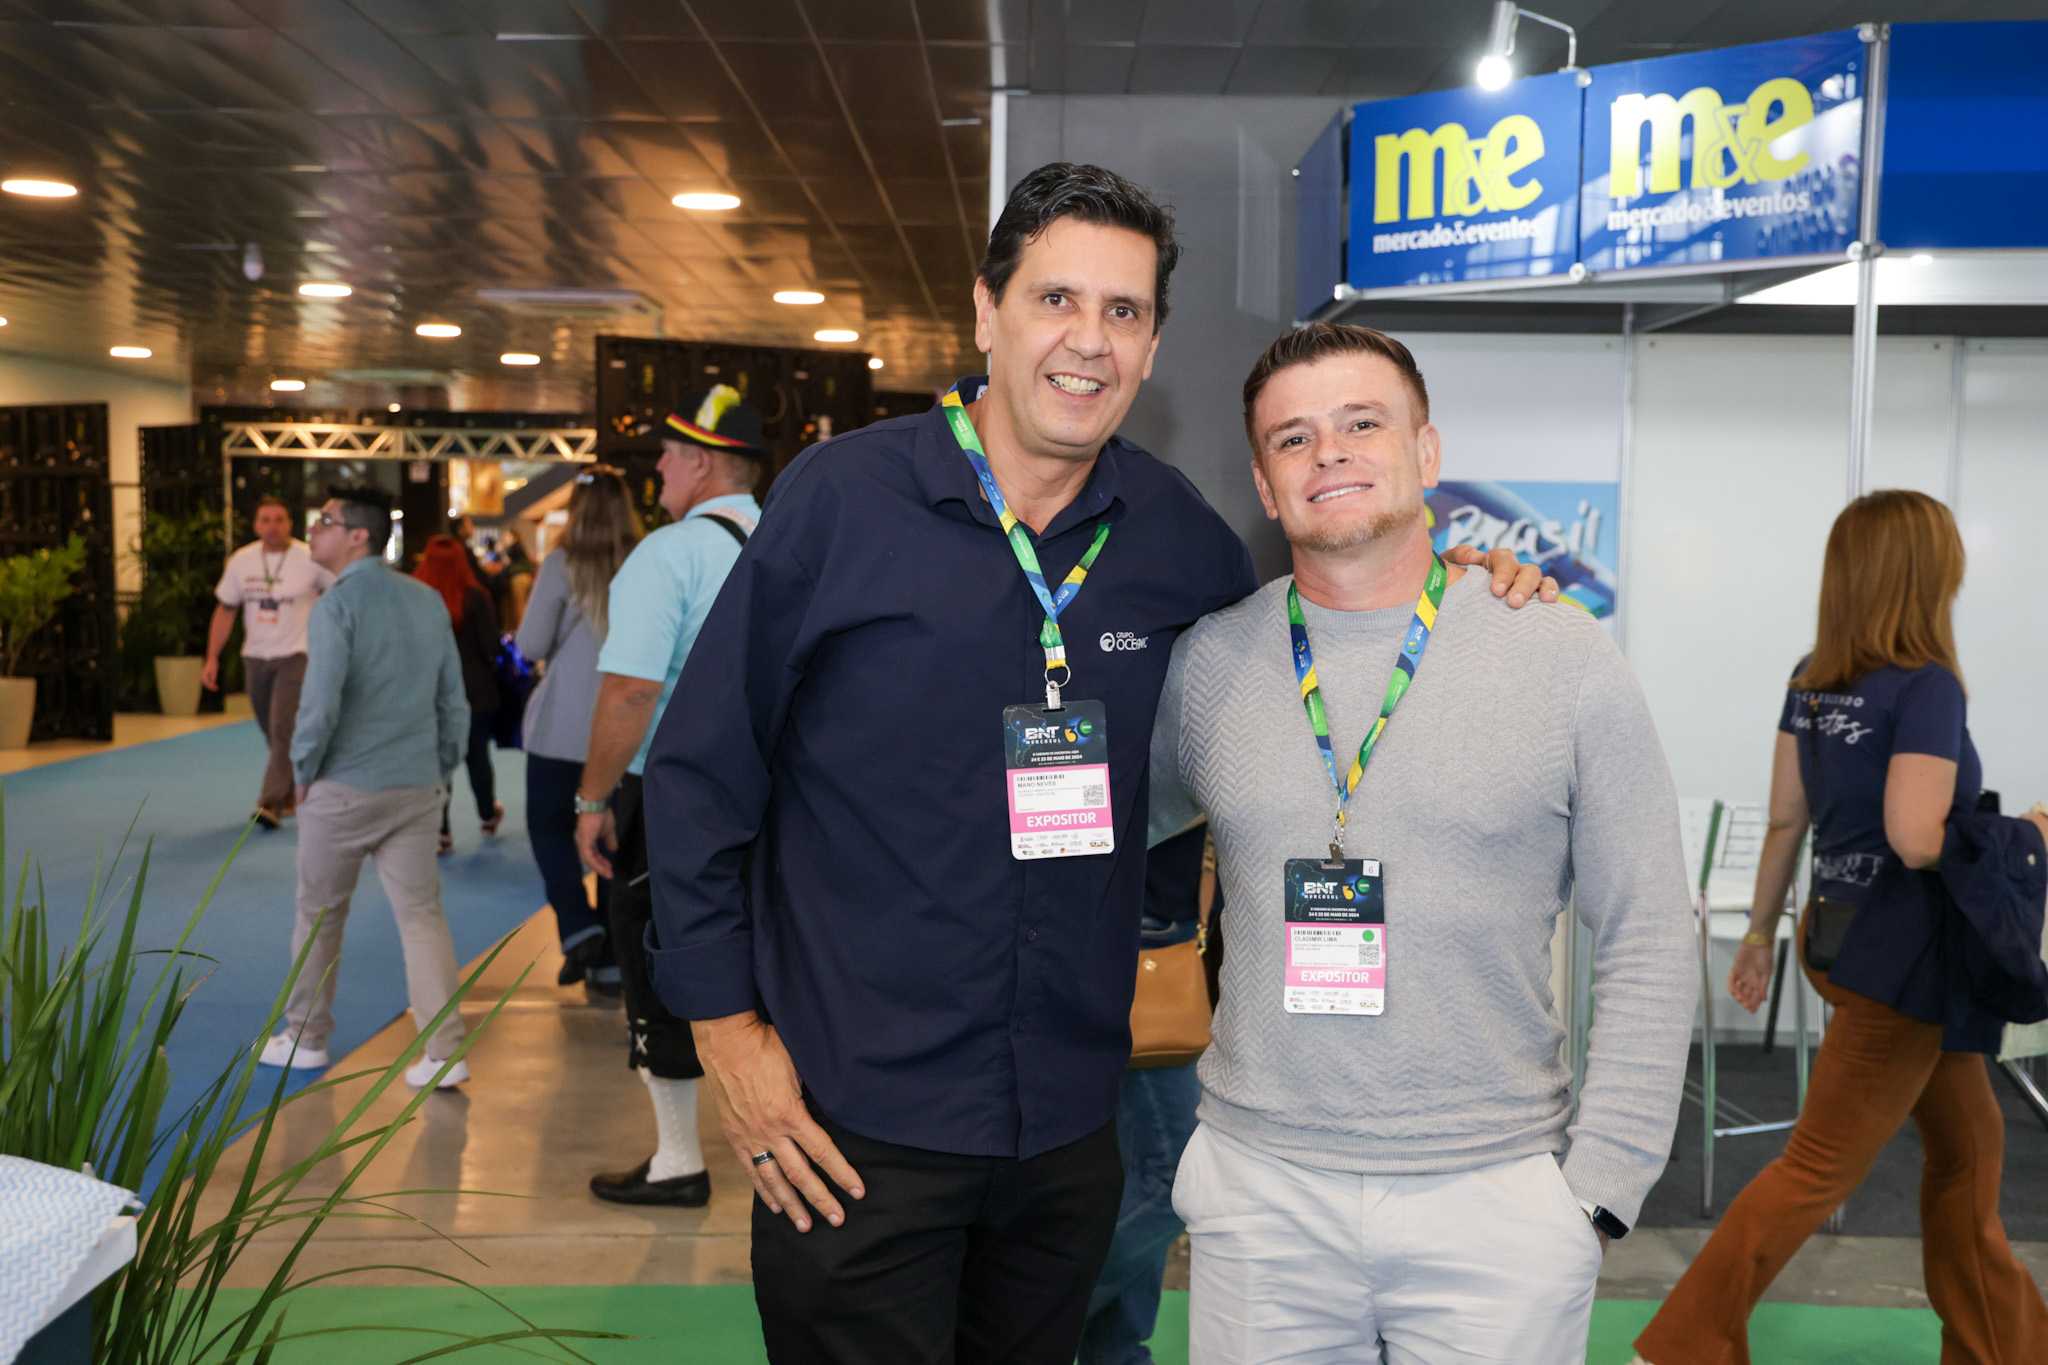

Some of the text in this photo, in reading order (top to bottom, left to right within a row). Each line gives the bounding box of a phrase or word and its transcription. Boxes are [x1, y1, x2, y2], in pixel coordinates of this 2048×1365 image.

[1609, 77, 1814, 198] m&e
[1373, 114, 1545, 224] m&e
[1446, 500, 1601, 565] Brasil
[1024, 726, 1060, 740] BNT
[1026, 812, 1096, 827] EXPOSITOR
[1304, 882, 1338, 894] BNT
[1300, 970, 1369, 983] EXPOSITOR
